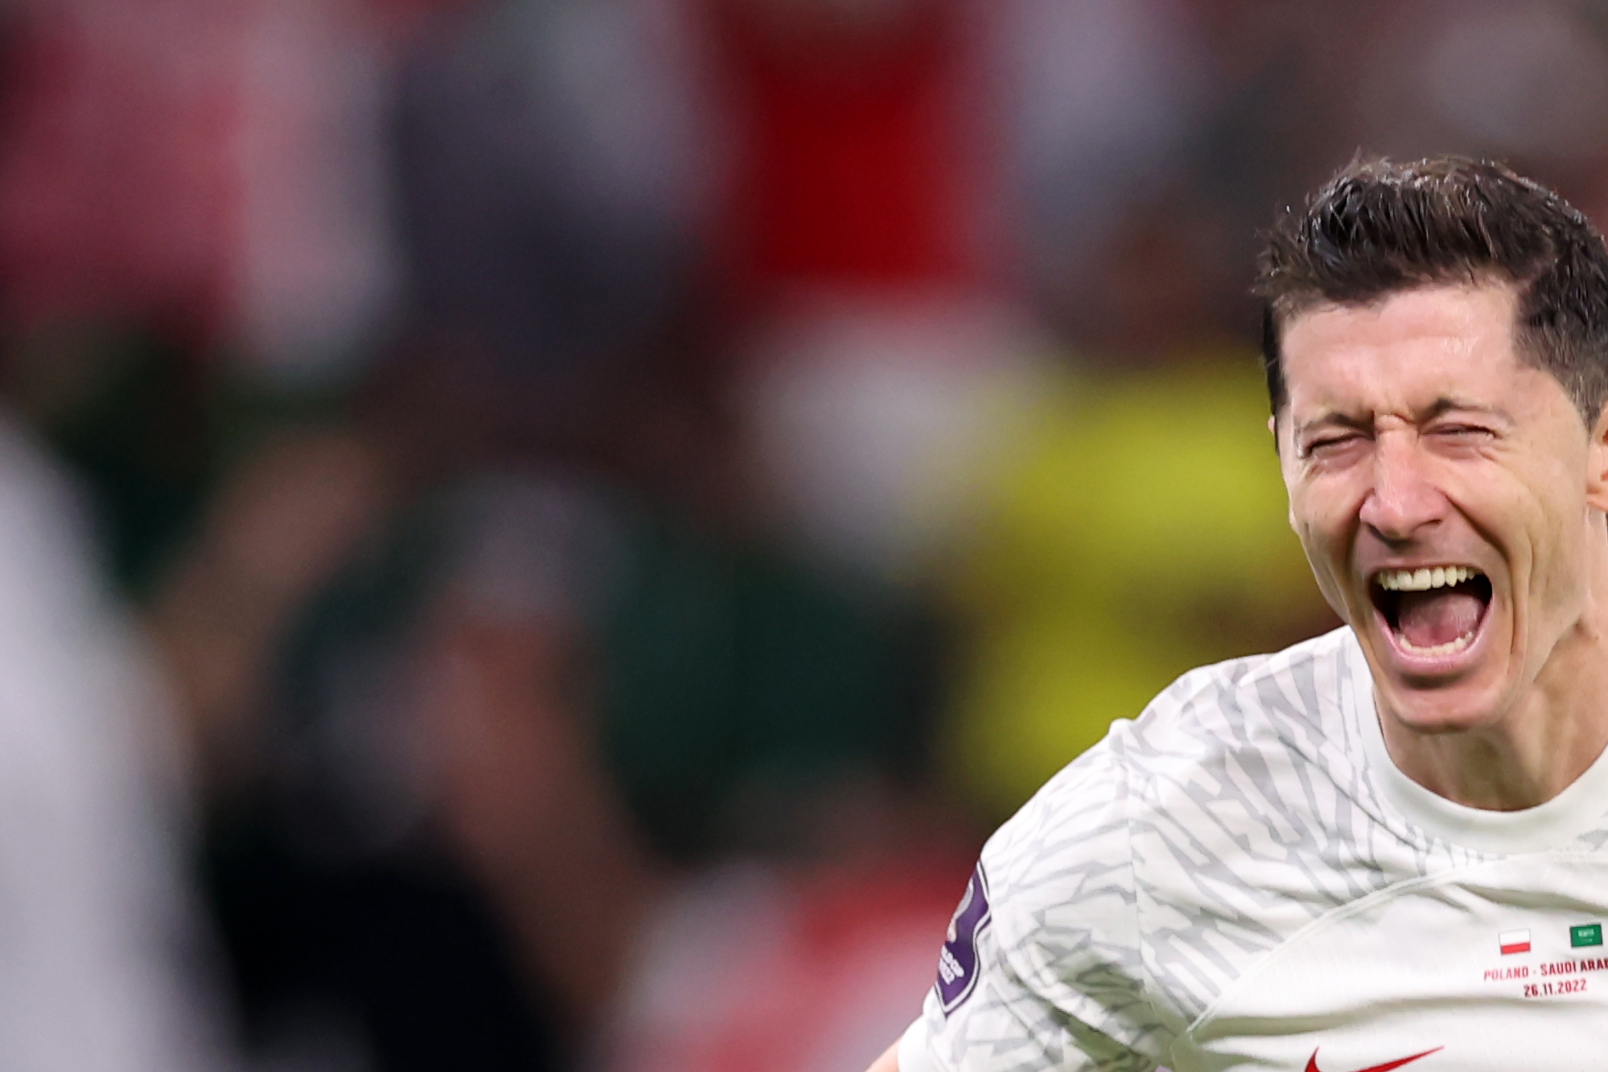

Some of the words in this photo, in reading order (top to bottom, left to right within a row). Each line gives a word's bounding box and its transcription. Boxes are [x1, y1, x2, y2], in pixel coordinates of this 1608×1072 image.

[1484, 966, 1528, 981] POLAND
[1540, 960, 1577, 977] SAUDI
[1524, 979, 1587, 997] 26.11.2022
